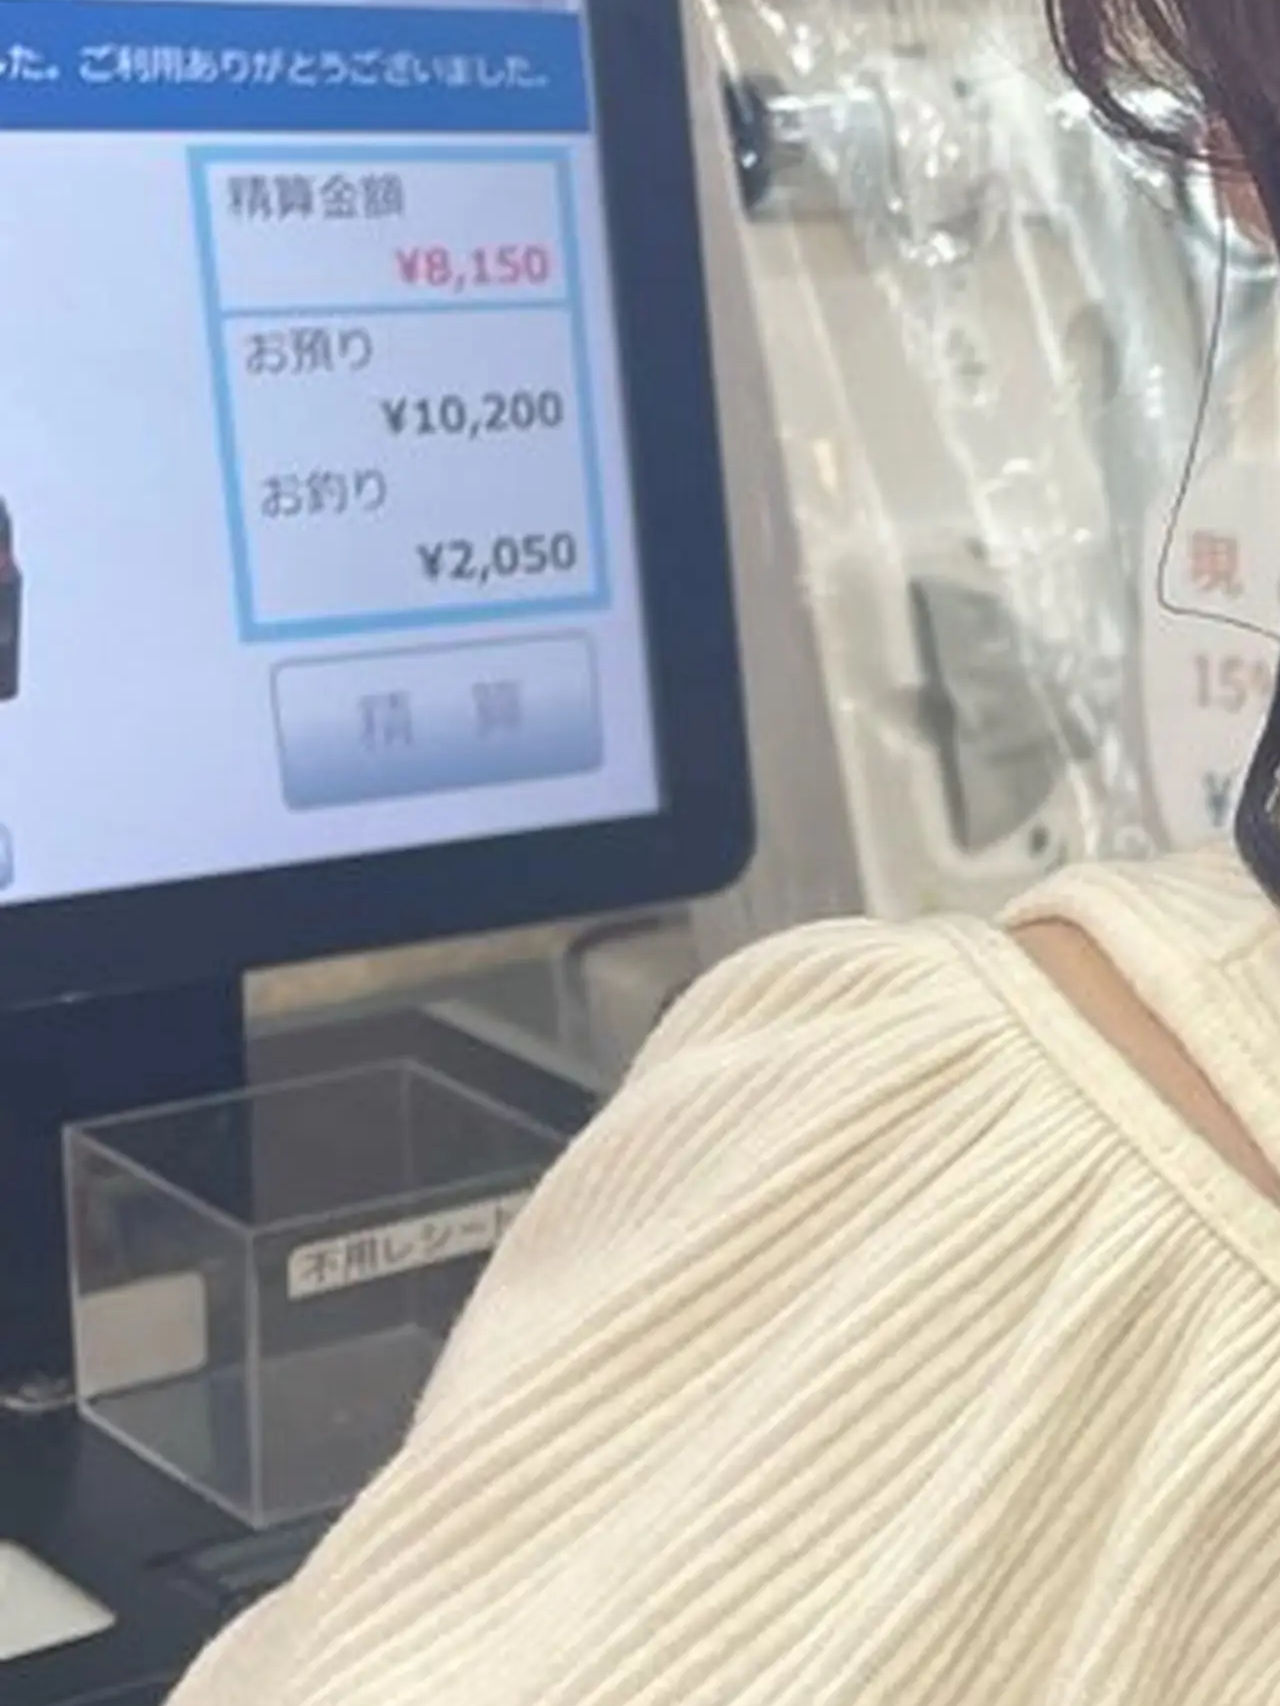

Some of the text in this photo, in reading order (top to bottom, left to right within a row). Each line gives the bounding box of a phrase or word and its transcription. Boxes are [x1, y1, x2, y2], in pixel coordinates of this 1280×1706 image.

[226, 174, 406, 221] 精算金額
[398, 244, 551, 291] ¥8,150
[245, 329, 373, 376] お預り
[381, 394, 563, 440] ¥10,200
[260, 470, 388, 518] お釣り
[418, 534, 578, 581] ¥2,050
